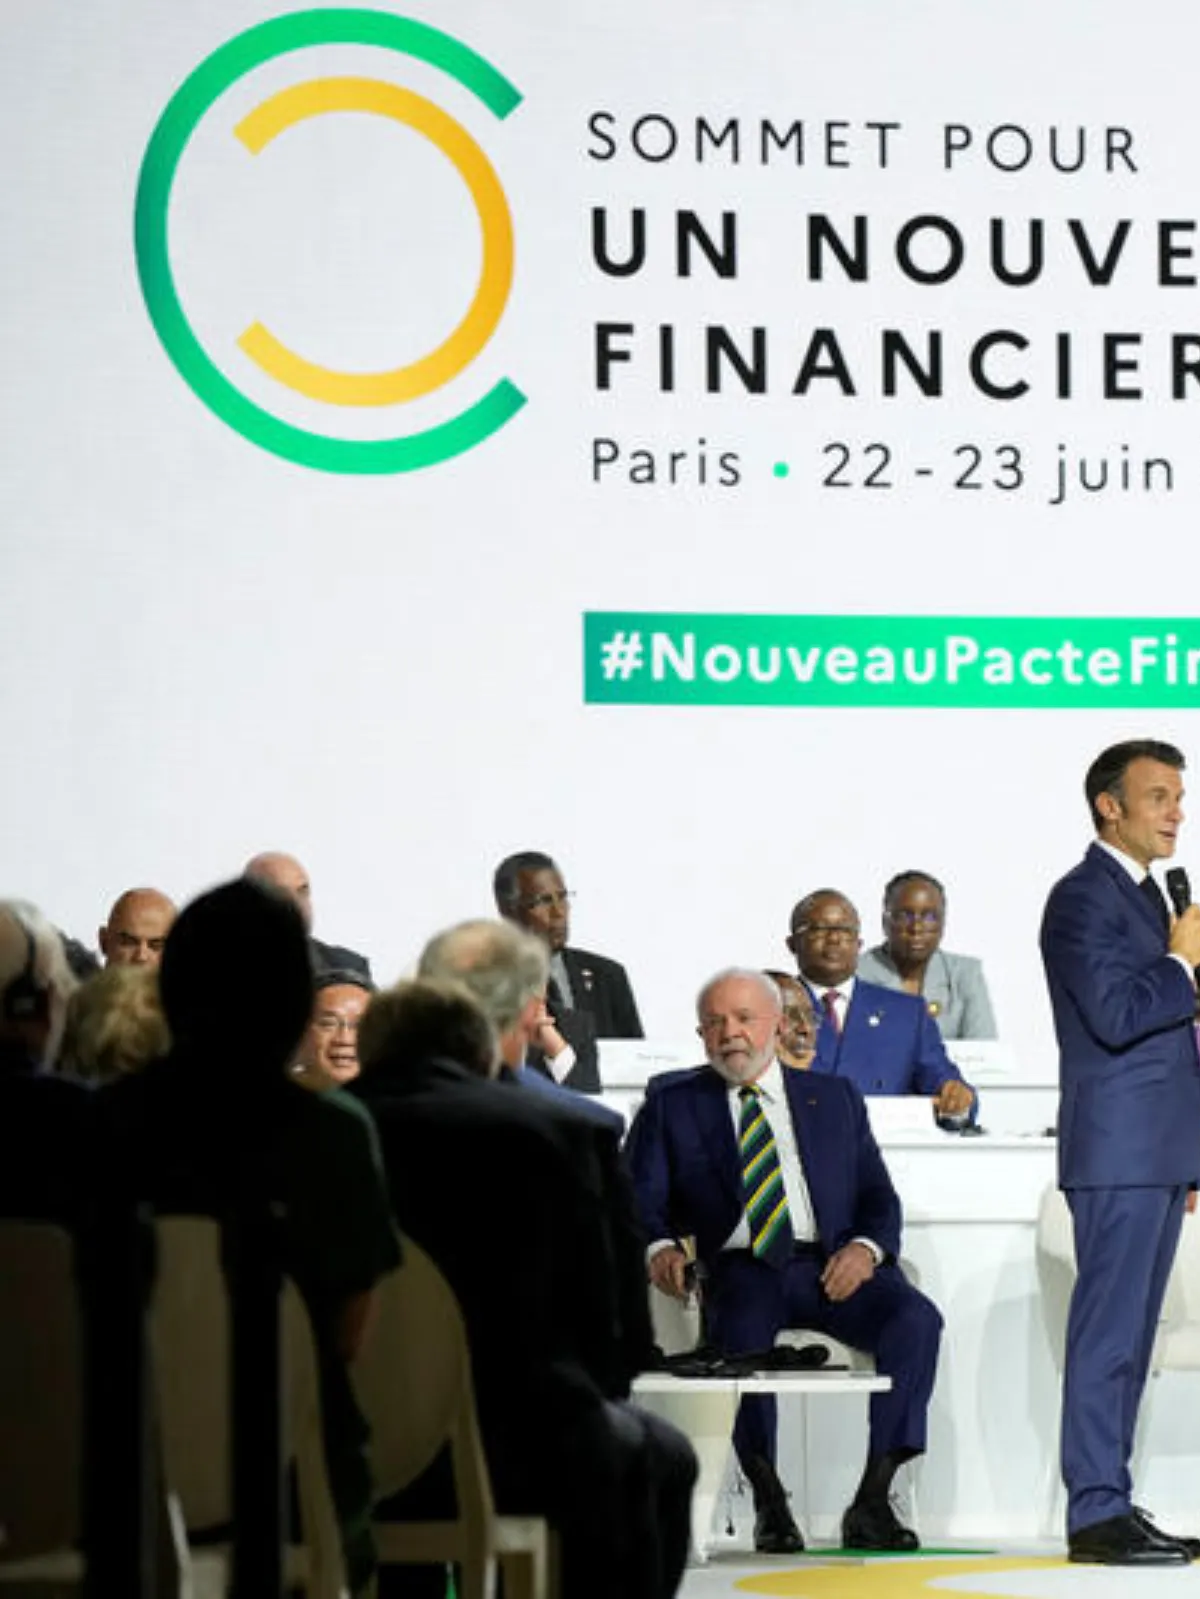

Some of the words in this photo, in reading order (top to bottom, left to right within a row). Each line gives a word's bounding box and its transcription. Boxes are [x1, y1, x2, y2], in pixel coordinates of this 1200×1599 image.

[588, 111, 904, 171] SOMMET
[944, 124, 1138, 173] POUR
[592, 206, 738, 280] UN
[592, 430, 740, 487] Paris
[1048, 444, 1173, 505] juin
